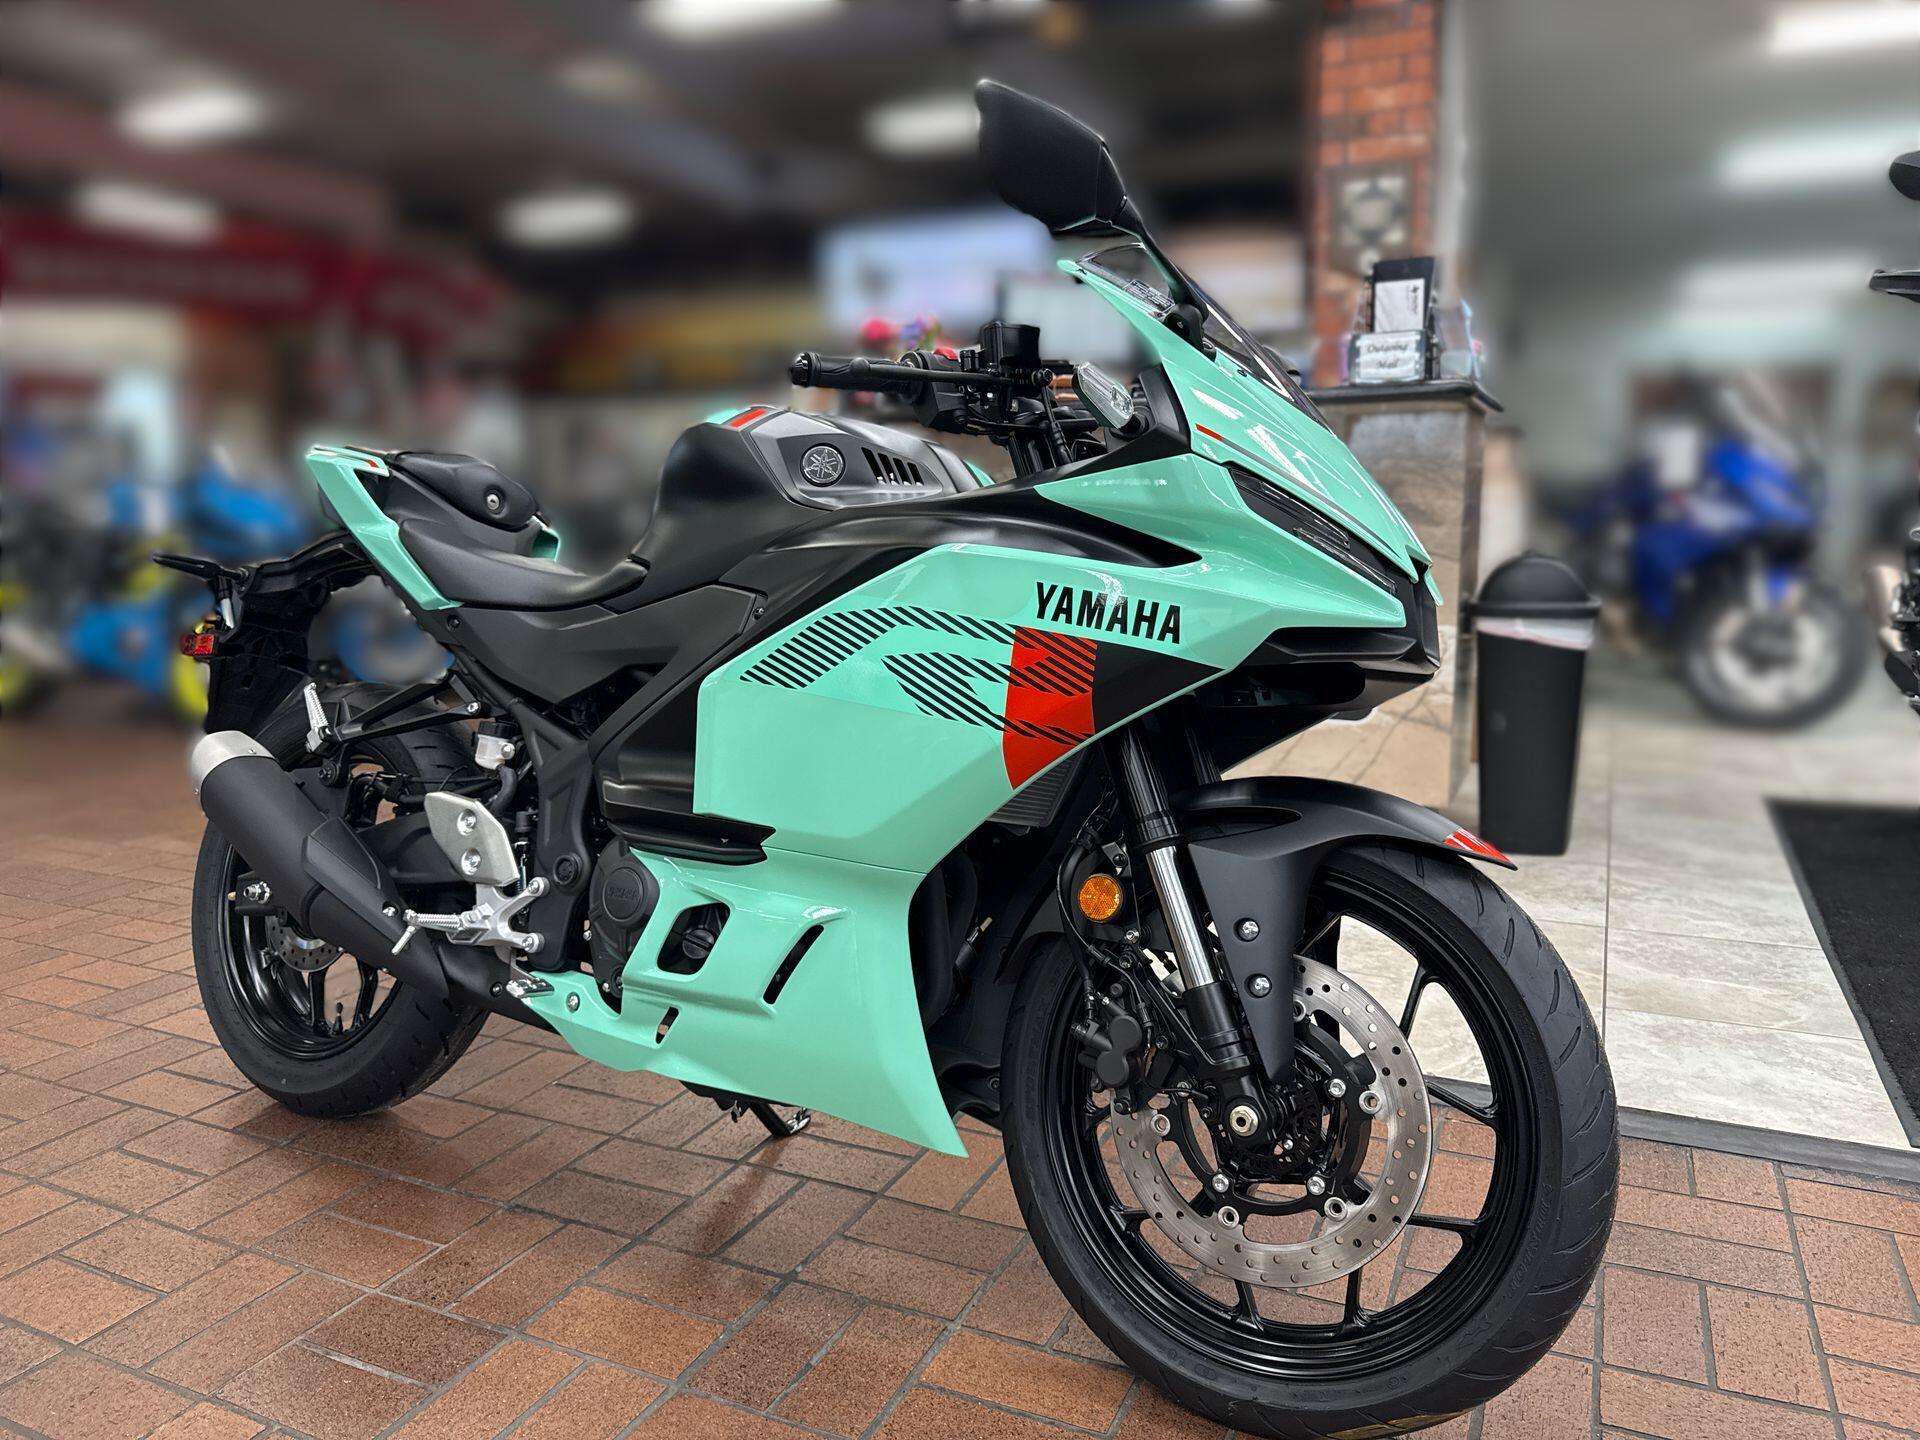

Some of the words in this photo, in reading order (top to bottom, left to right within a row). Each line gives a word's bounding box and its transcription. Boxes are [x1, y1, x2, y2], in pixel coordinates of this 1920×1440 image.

[1367, 341, 1408, 353] Outgoing
[1376, 358, 1400, 369] Mail
[1036, 582, 1181, 644] YAMAHA
